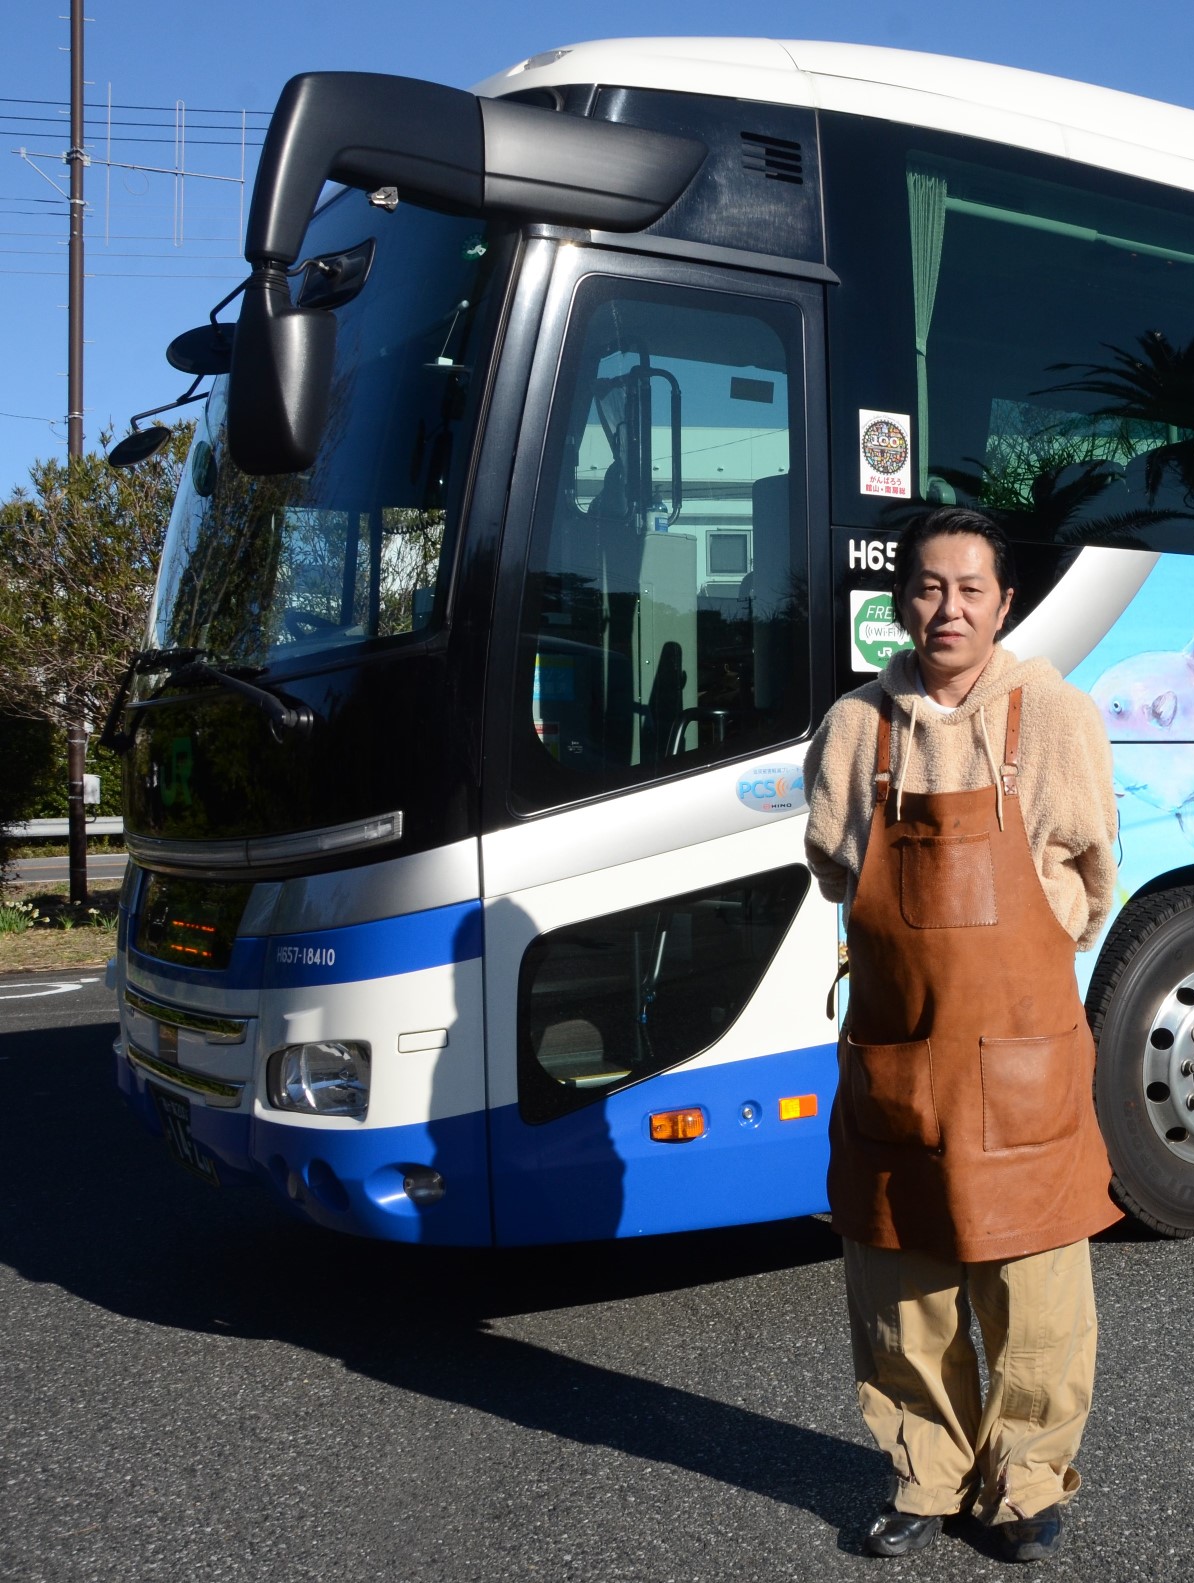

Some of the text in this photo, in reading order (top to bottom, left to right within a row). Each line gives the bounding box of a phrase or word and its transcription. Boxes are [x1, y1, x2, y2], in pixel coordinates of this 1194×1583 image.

[869, 475, 903, 486] がんばろう
[865, 484, 906, 496] 館山・南房総
[877, 646, 893, 658] JR
[160, 735, 193, 808] JR
[739, 779, 776, 799] PCS
[276, 946, 336, 966] H657-18410
